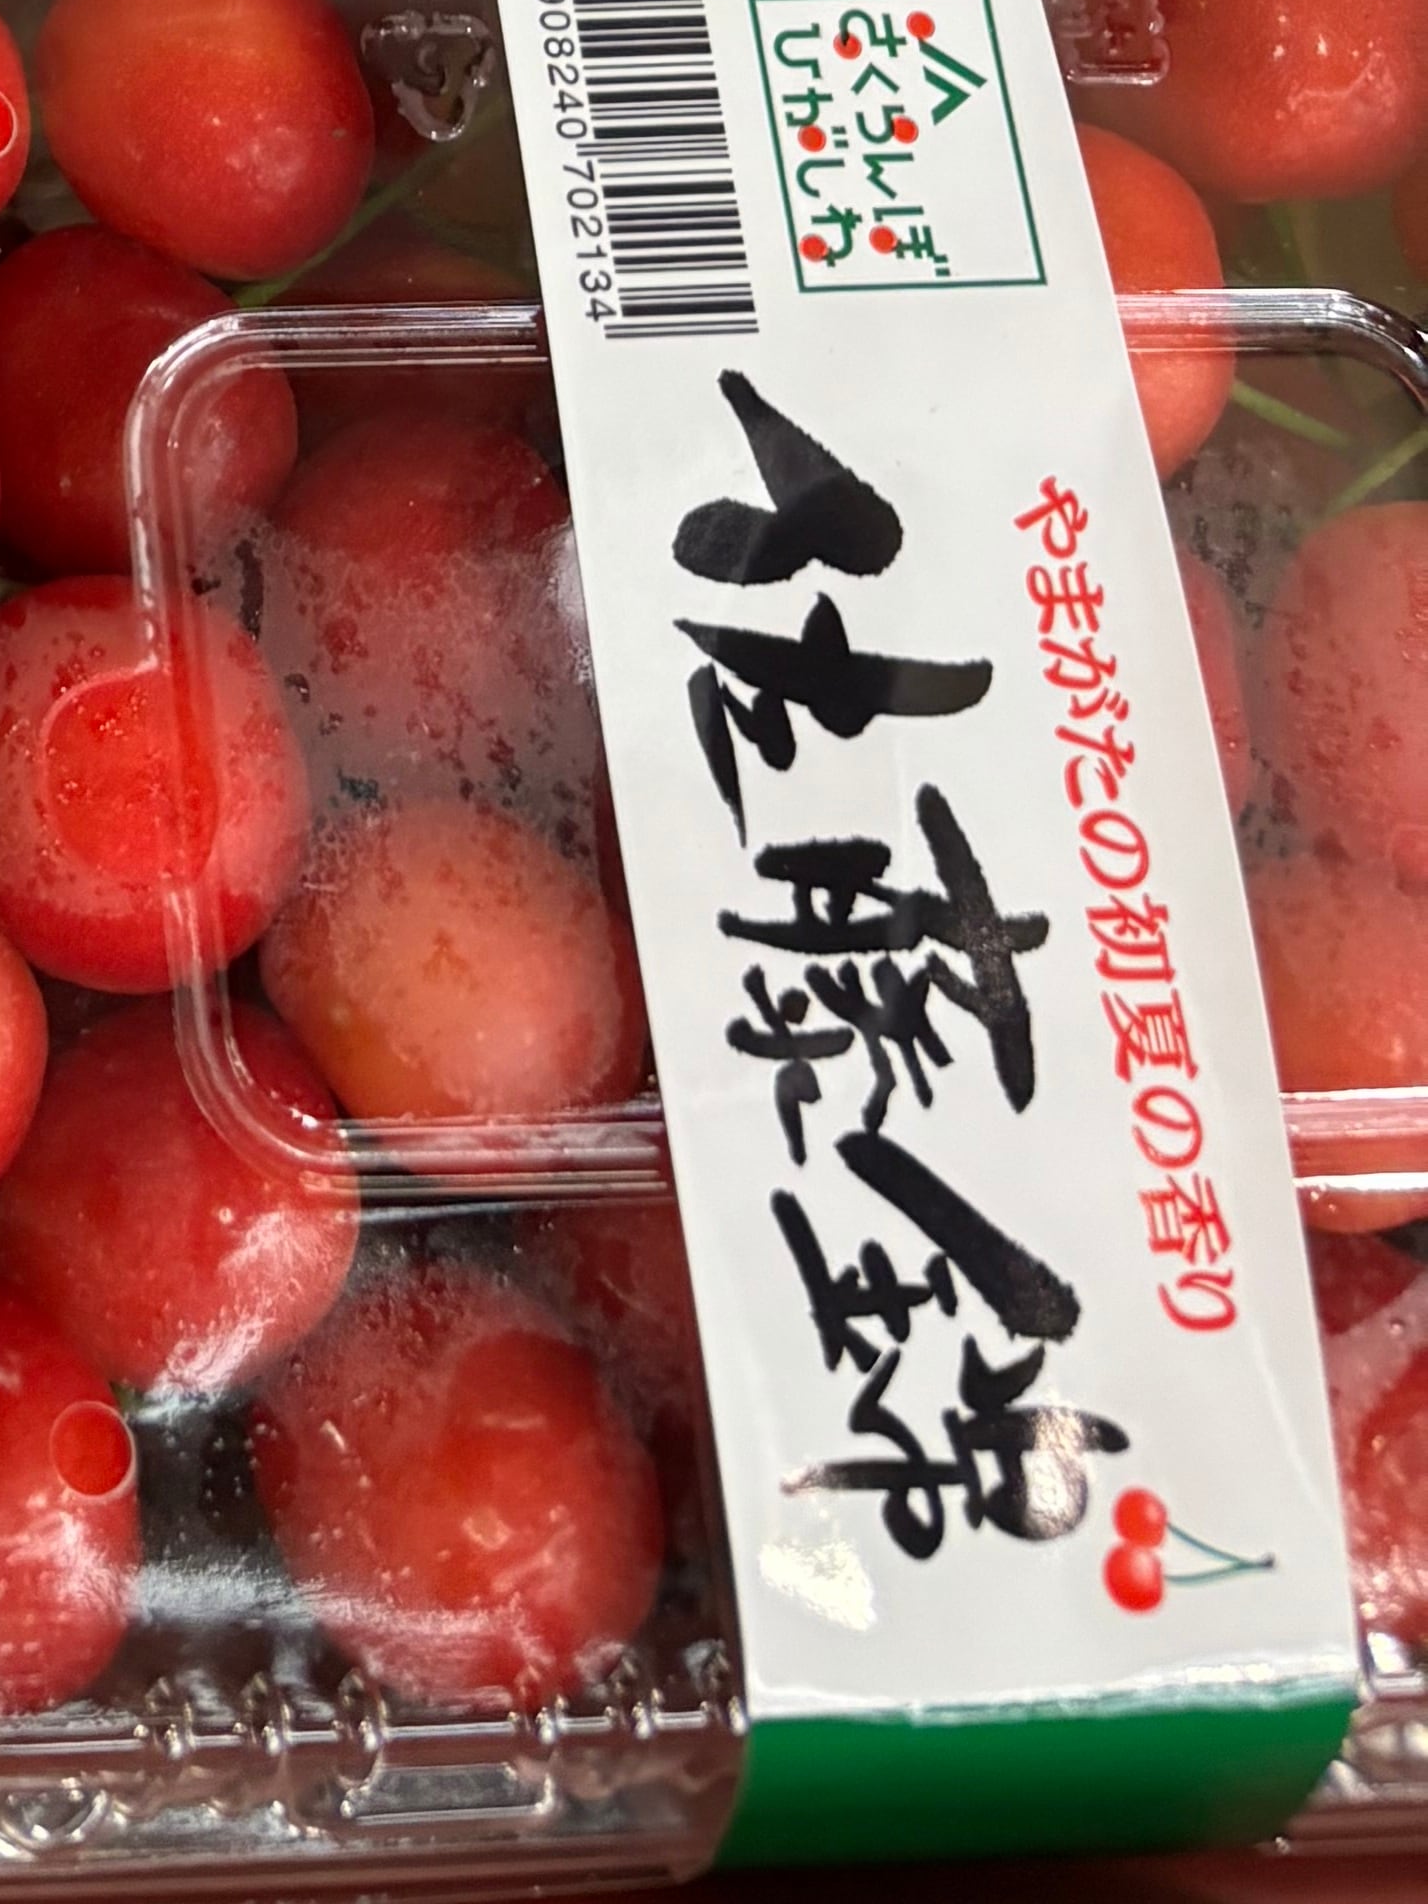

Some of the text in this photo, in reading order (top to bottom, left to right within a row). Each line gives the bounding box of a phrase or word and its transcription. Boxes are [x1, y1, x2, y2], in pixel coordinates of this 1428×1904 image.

[561, 160, 617, 323] 702134
[833, 9, 951, 277] さくらんぼ
[673, 371, 1129, 1560] 佐藤錦
[1013, 477, 1239, 1335] やまがたの初夏の香り
